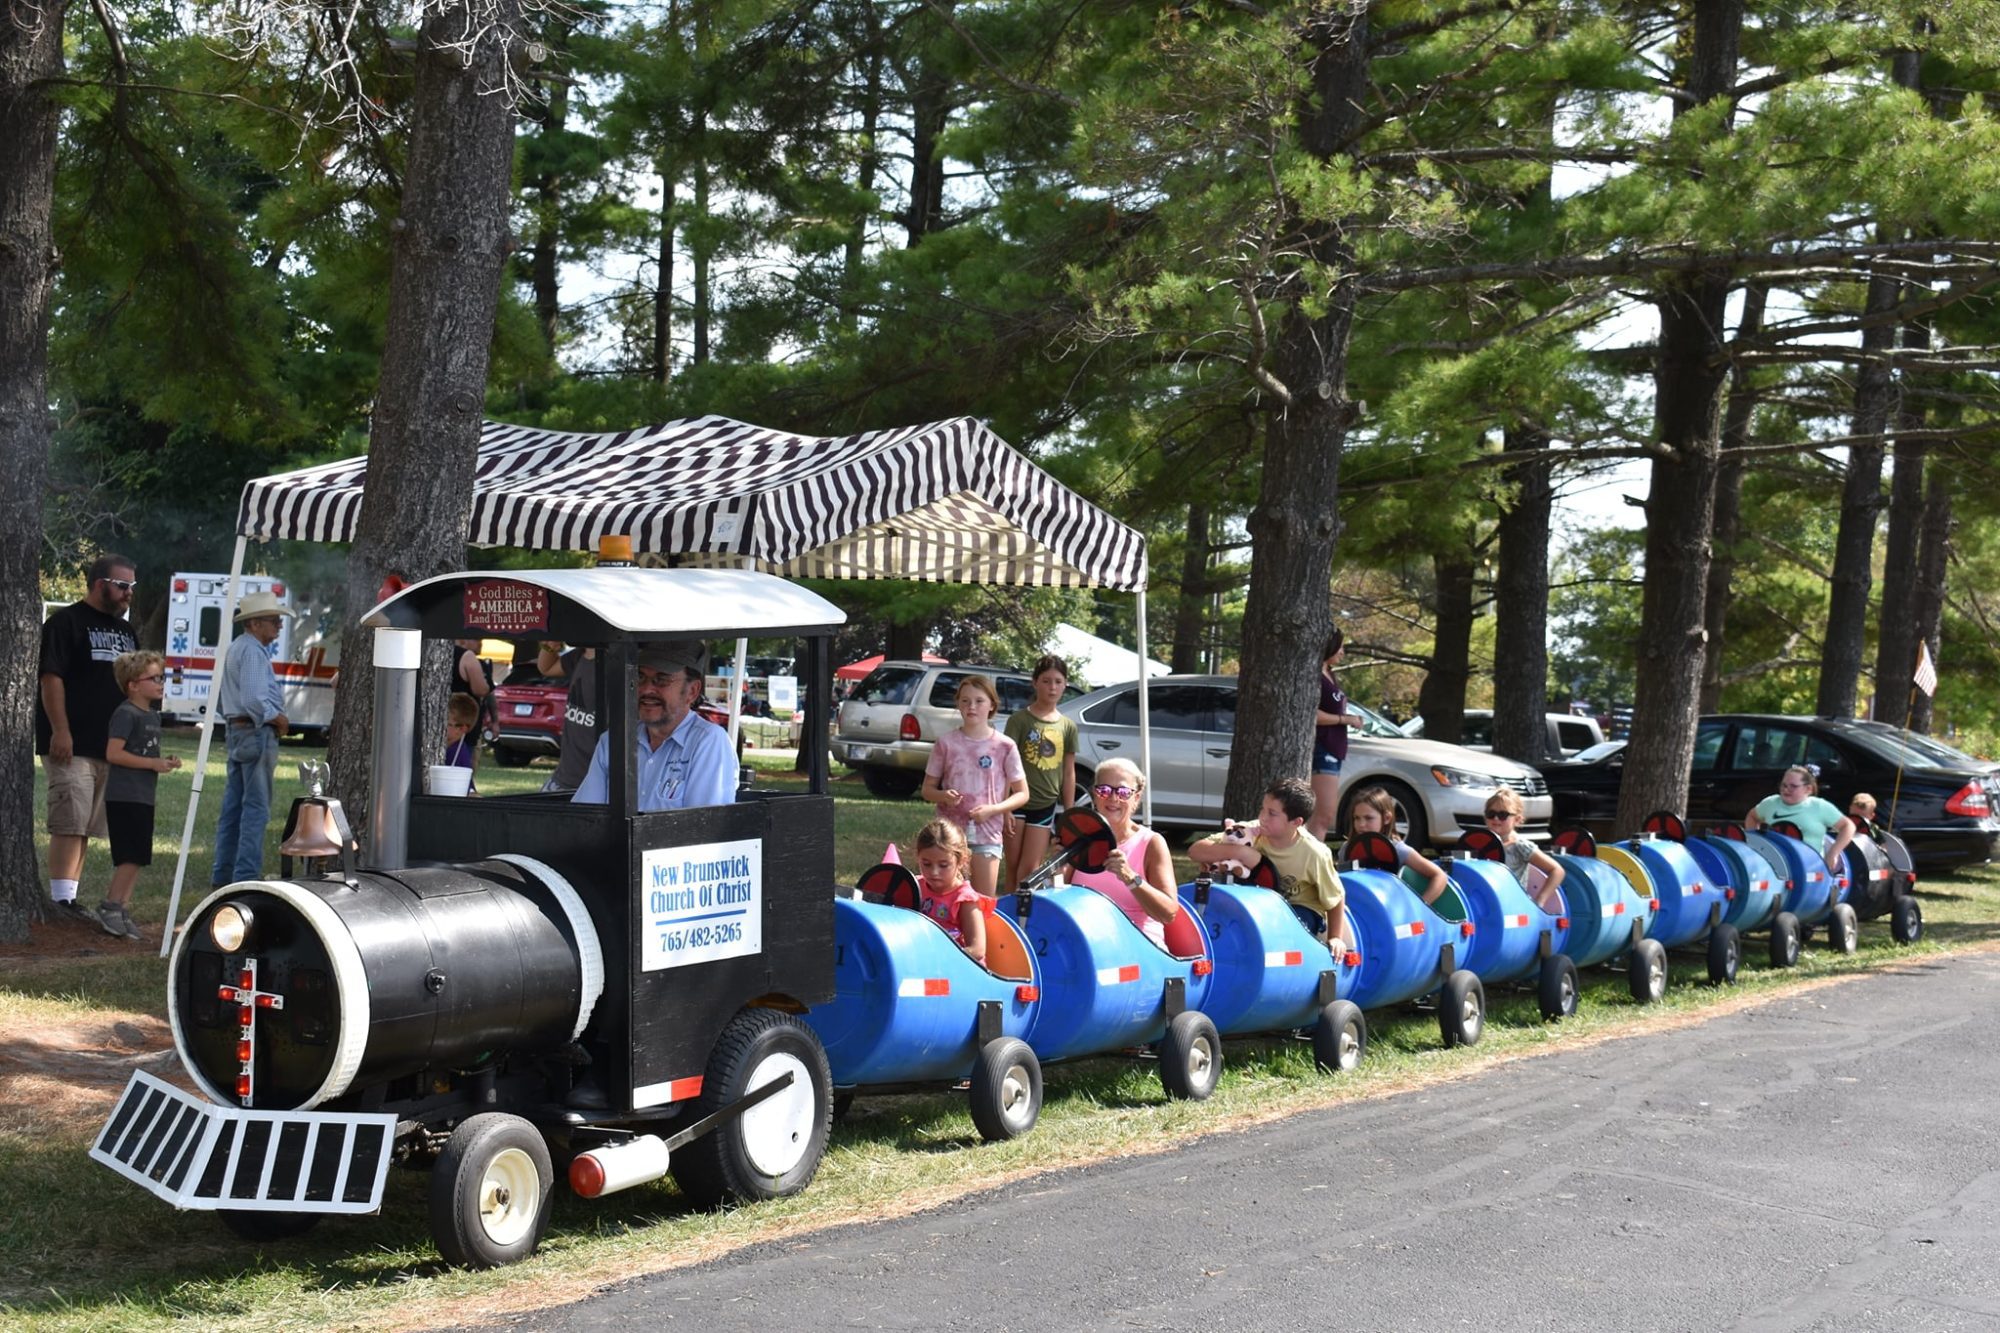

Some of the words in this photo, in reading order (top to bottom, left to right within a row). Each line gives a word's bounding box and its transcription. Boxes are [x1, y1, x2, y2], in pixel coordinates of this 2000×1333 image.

[479, 586, 500, 600] God
[504, 586, 533, 600] Bless
[478, 600, 533, 613] AMERICA
[469, 614, 490, 624] Land
[491, 614, 511, 624] That
[513, 614, 517, 624] I
[519, 614, 540, 624] Love
[652, 864, 679, 888] New
[683, 855, 750, 884] Brunswick
[650, 887, 695, 914] Church
[699, 884, 712, 907] Of
[717, 879, 751, 905] Christ
[660, 922, 742, 952] 765/482-5265
[1209, 922, 1221, 940] 3
[835, 943, 845, 966] 1
[1037, 937, 1048, 957] 2
